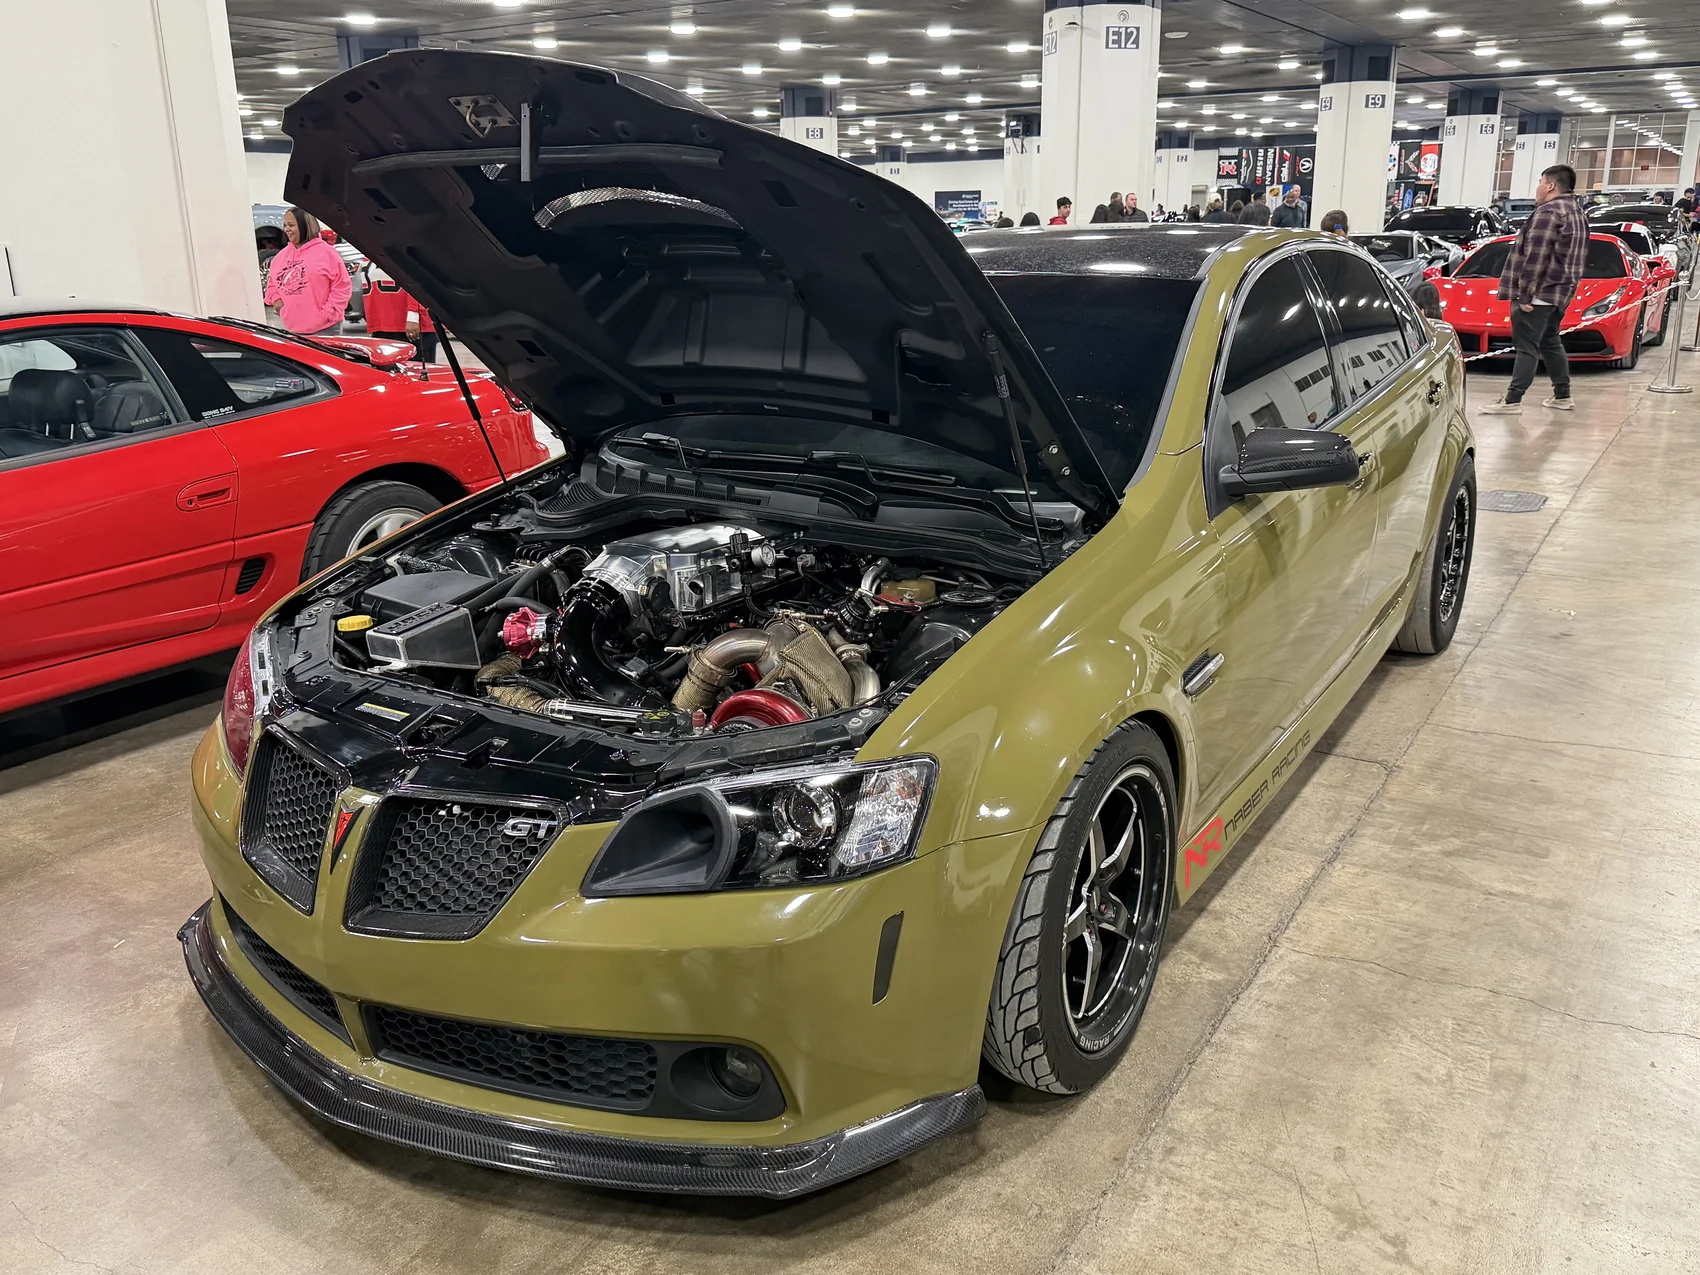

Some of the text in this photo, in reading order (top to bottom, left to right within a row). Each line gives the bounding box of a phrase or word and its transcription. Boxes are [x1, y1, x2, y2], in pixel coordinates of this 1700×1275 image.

[1044, 31, 1057, 56] E12
[1107, 27, 1137, 49] E12
[1321, 96, 1331, 111] E9
[1367, 94, 1382, 108] E9
[808, 128, 821, 139] E8
[1446, 125, 1455, 136] E6
[1481, 124, 1492, 134] E6
[1265, 148, 1275, 185] NISSAN
[1224, 779, 1269, 841] NABER
[1271, 729, 1311, 785] RACING
[504, 818, 558, 839] GT
[1079, 1034, 1110, 1051] RACING
